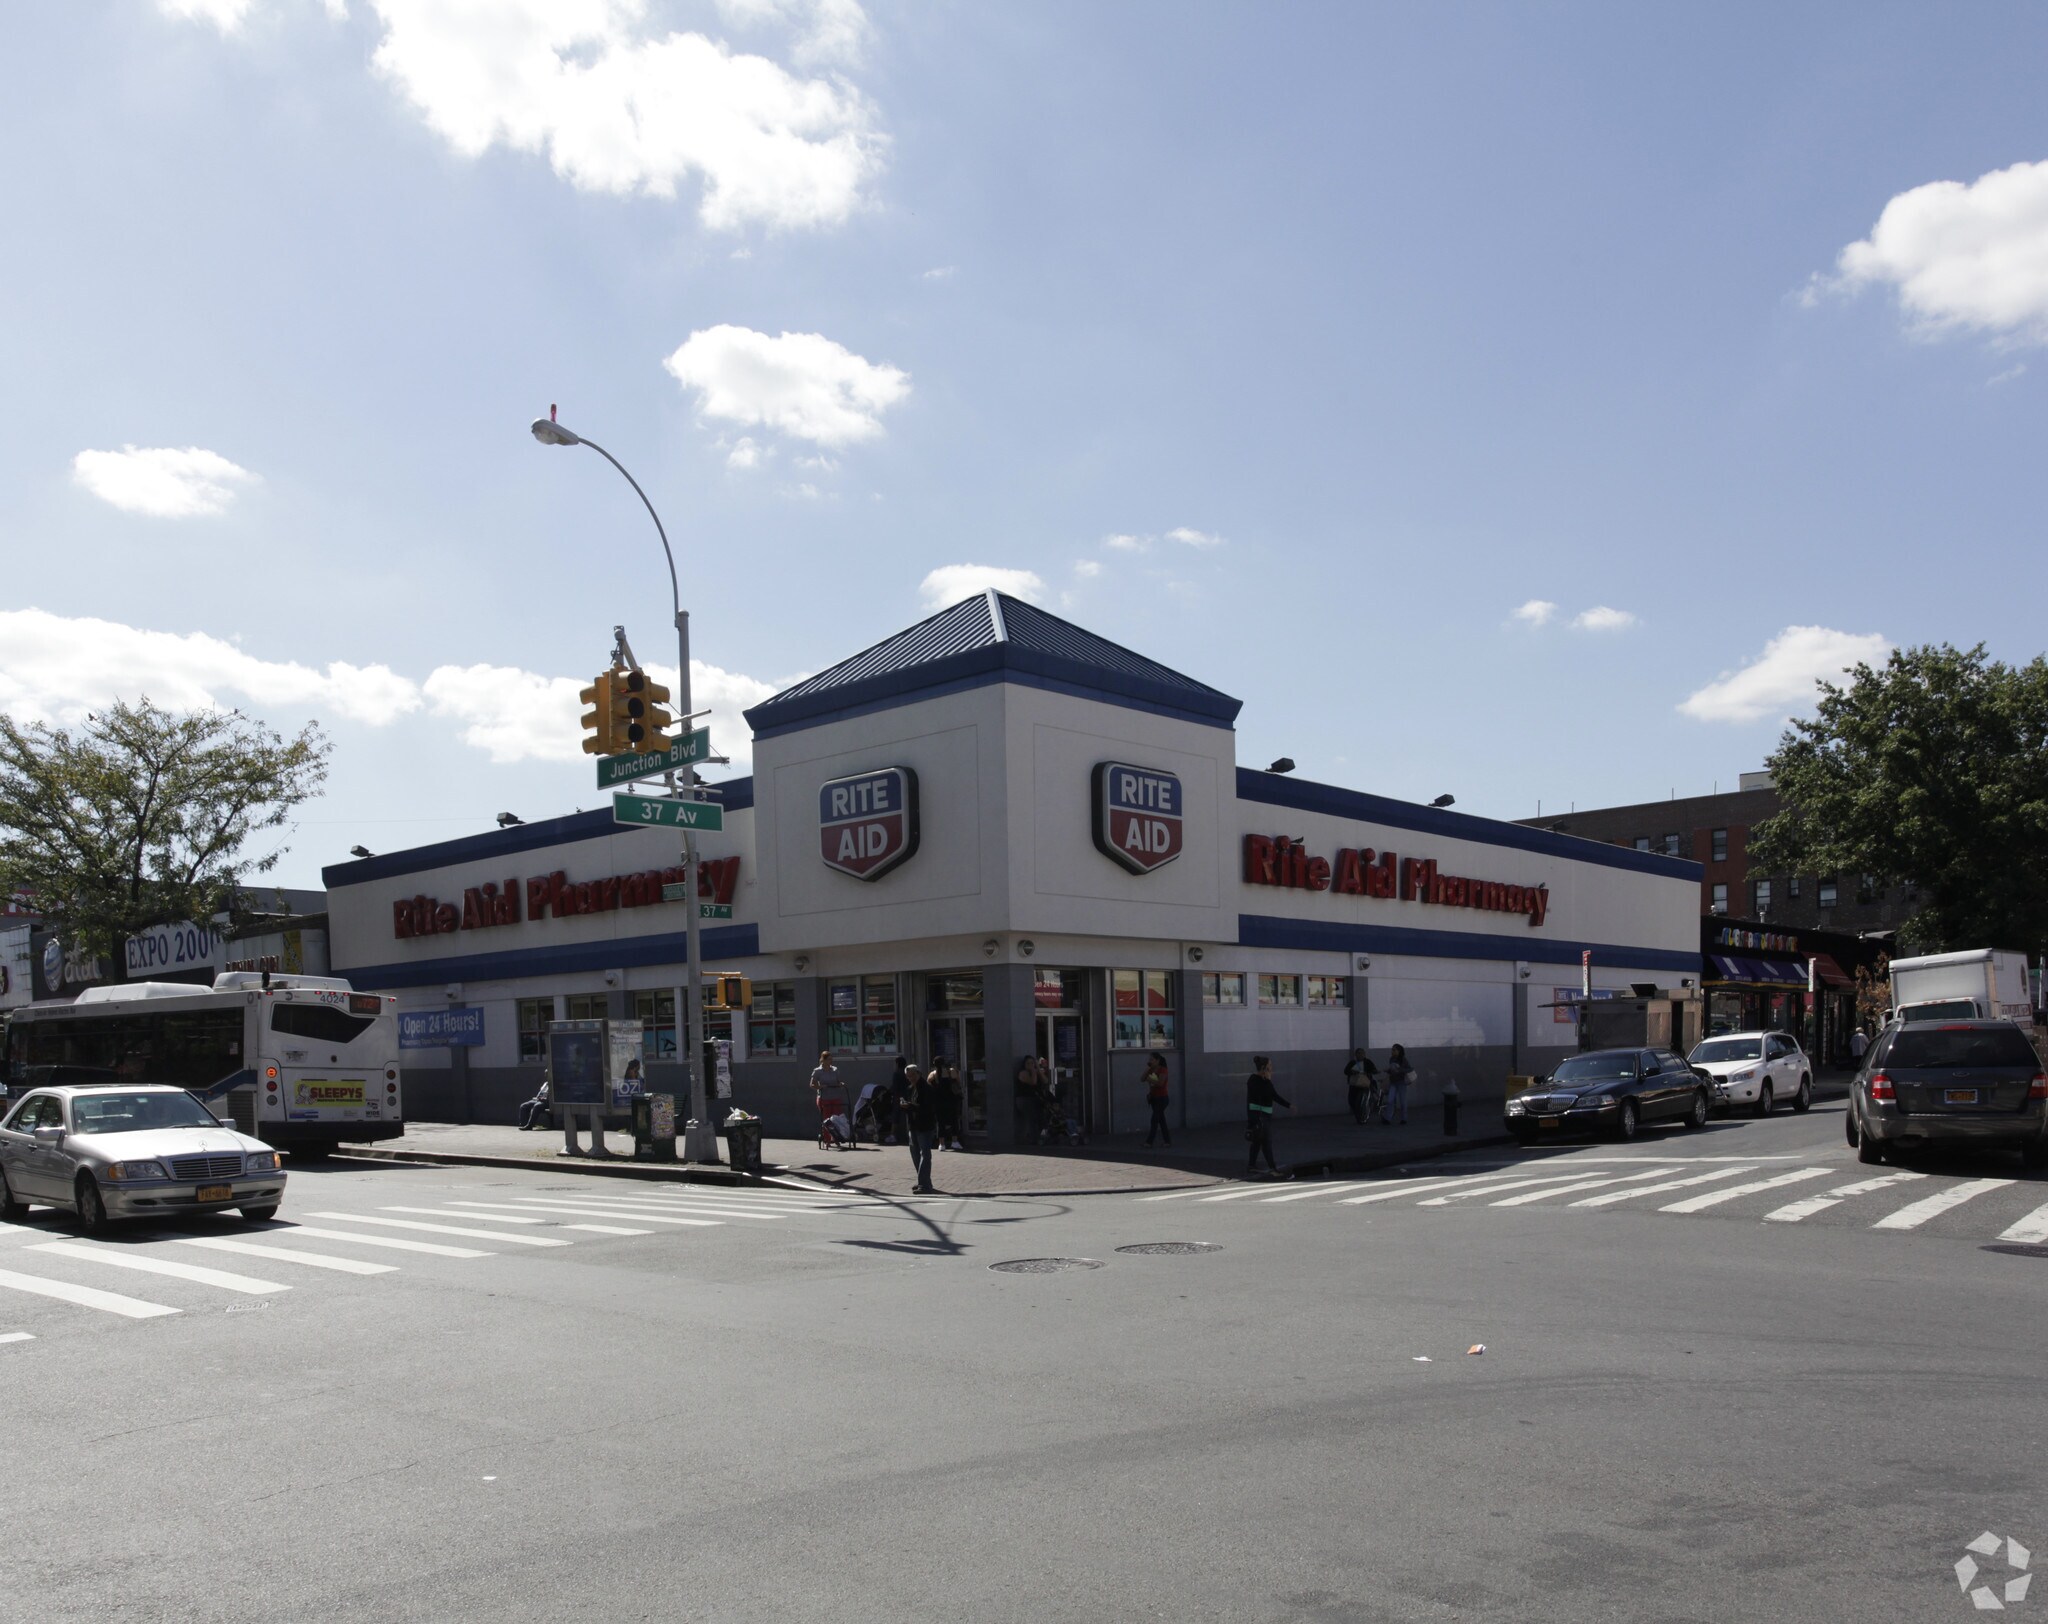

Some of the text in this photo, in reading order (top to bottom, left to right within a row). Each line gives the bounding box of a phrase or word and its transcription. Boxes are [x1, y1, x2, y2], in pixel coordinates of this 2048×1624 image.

[610, 742, 697, 779] Junction Blvd
[830, 778, 889, 818] RITE
[1120, 773, 1172, 810] RITE
[641, 802, 698, 825] 37 Av
[837, 823, 888, 862] AID
[1124, 817, 1171, 855] AID
[1244, 833, 1549, 927] Rite Aid Pharmacy
[393, 893, 460, 940] Rite
[460, 878, 521, 931] Aid
[703, 905, 716, 918] 37
[127, 933, 169, 970] EXPO
[319, 995, 345, 1004] 4024
[403, 1010, 480, 1038] Open 24 Hours!
[619, 1081, 639, 1095] OZ
